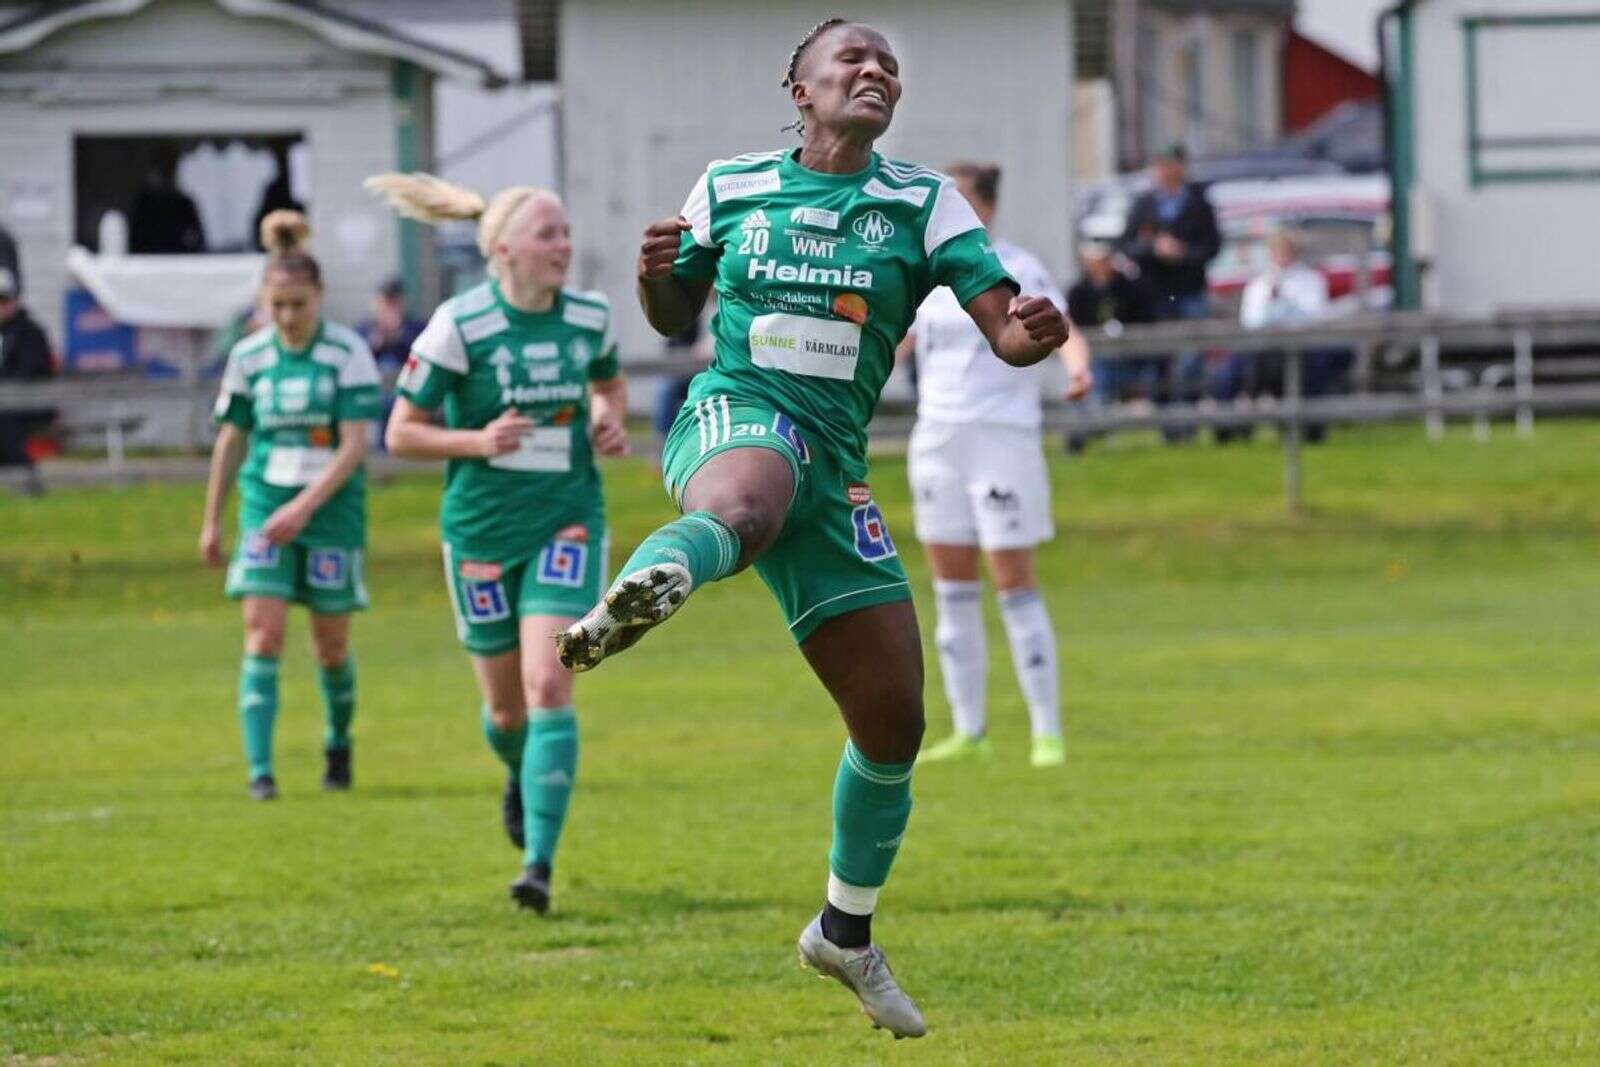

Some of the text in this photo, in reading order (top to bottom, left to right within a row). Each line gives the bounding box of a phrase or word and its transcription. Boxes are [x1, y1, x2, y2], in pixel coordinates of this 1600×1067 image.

[737, 228, 769, 255] 20
[792, 236, 837, 259] WMT
[748, 258, 873, 288] Helmia
[752, 334, 858, 357] SUNNE VÄRMLAND
[732, 423, 766, 436] 20
